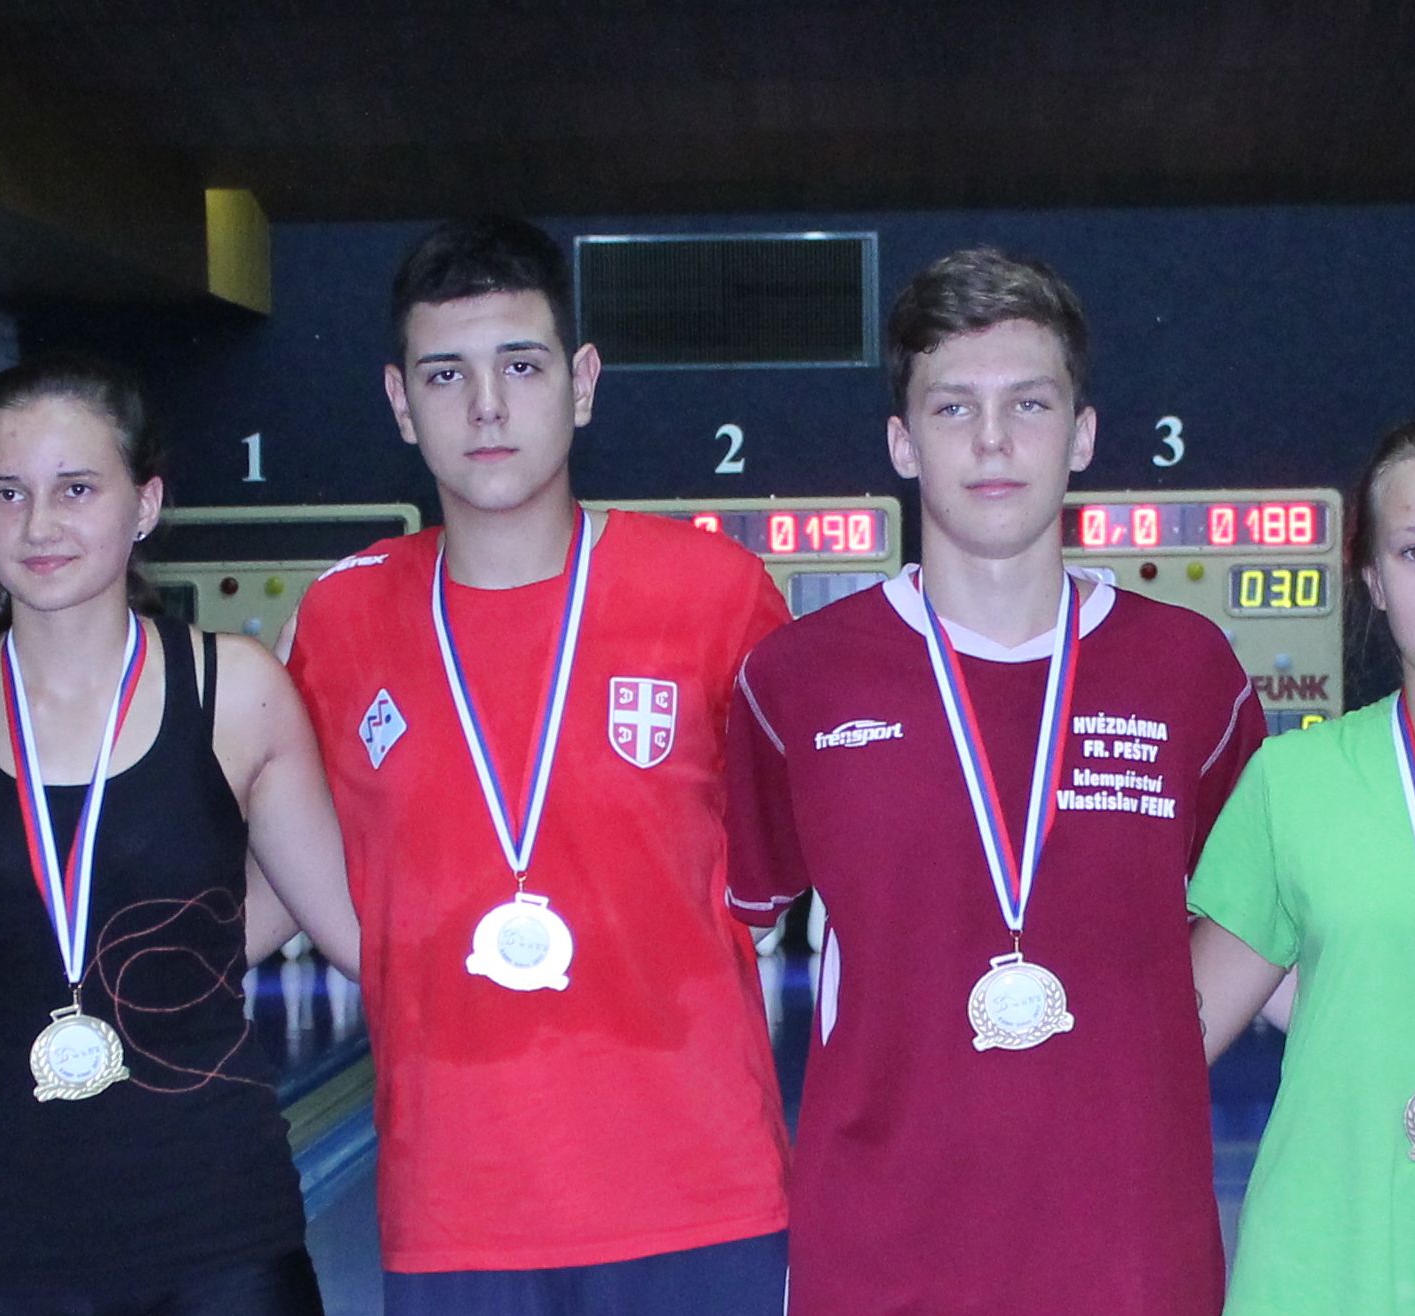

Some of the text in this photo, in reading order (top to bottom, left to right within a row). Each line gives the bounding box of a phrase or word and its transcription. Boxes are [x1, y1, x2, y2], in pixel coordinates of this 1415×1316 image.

[240, 432, 266, 482] 1
[714, 423, 746, 474] 2
[1152, 416, 1185, 467] 3
[769, 513, 874, 552] 0190
[1210, 506, 1314, 545] 0188
[1250, 674, 1329, 701] FUNK
[1072, 711, 1168, 741] HVĚZDÁRNA
[1083, 738, 1159, 763] FR. PEŠTY
[1056, 790, 1176, 819] Vlastislav FEIK
